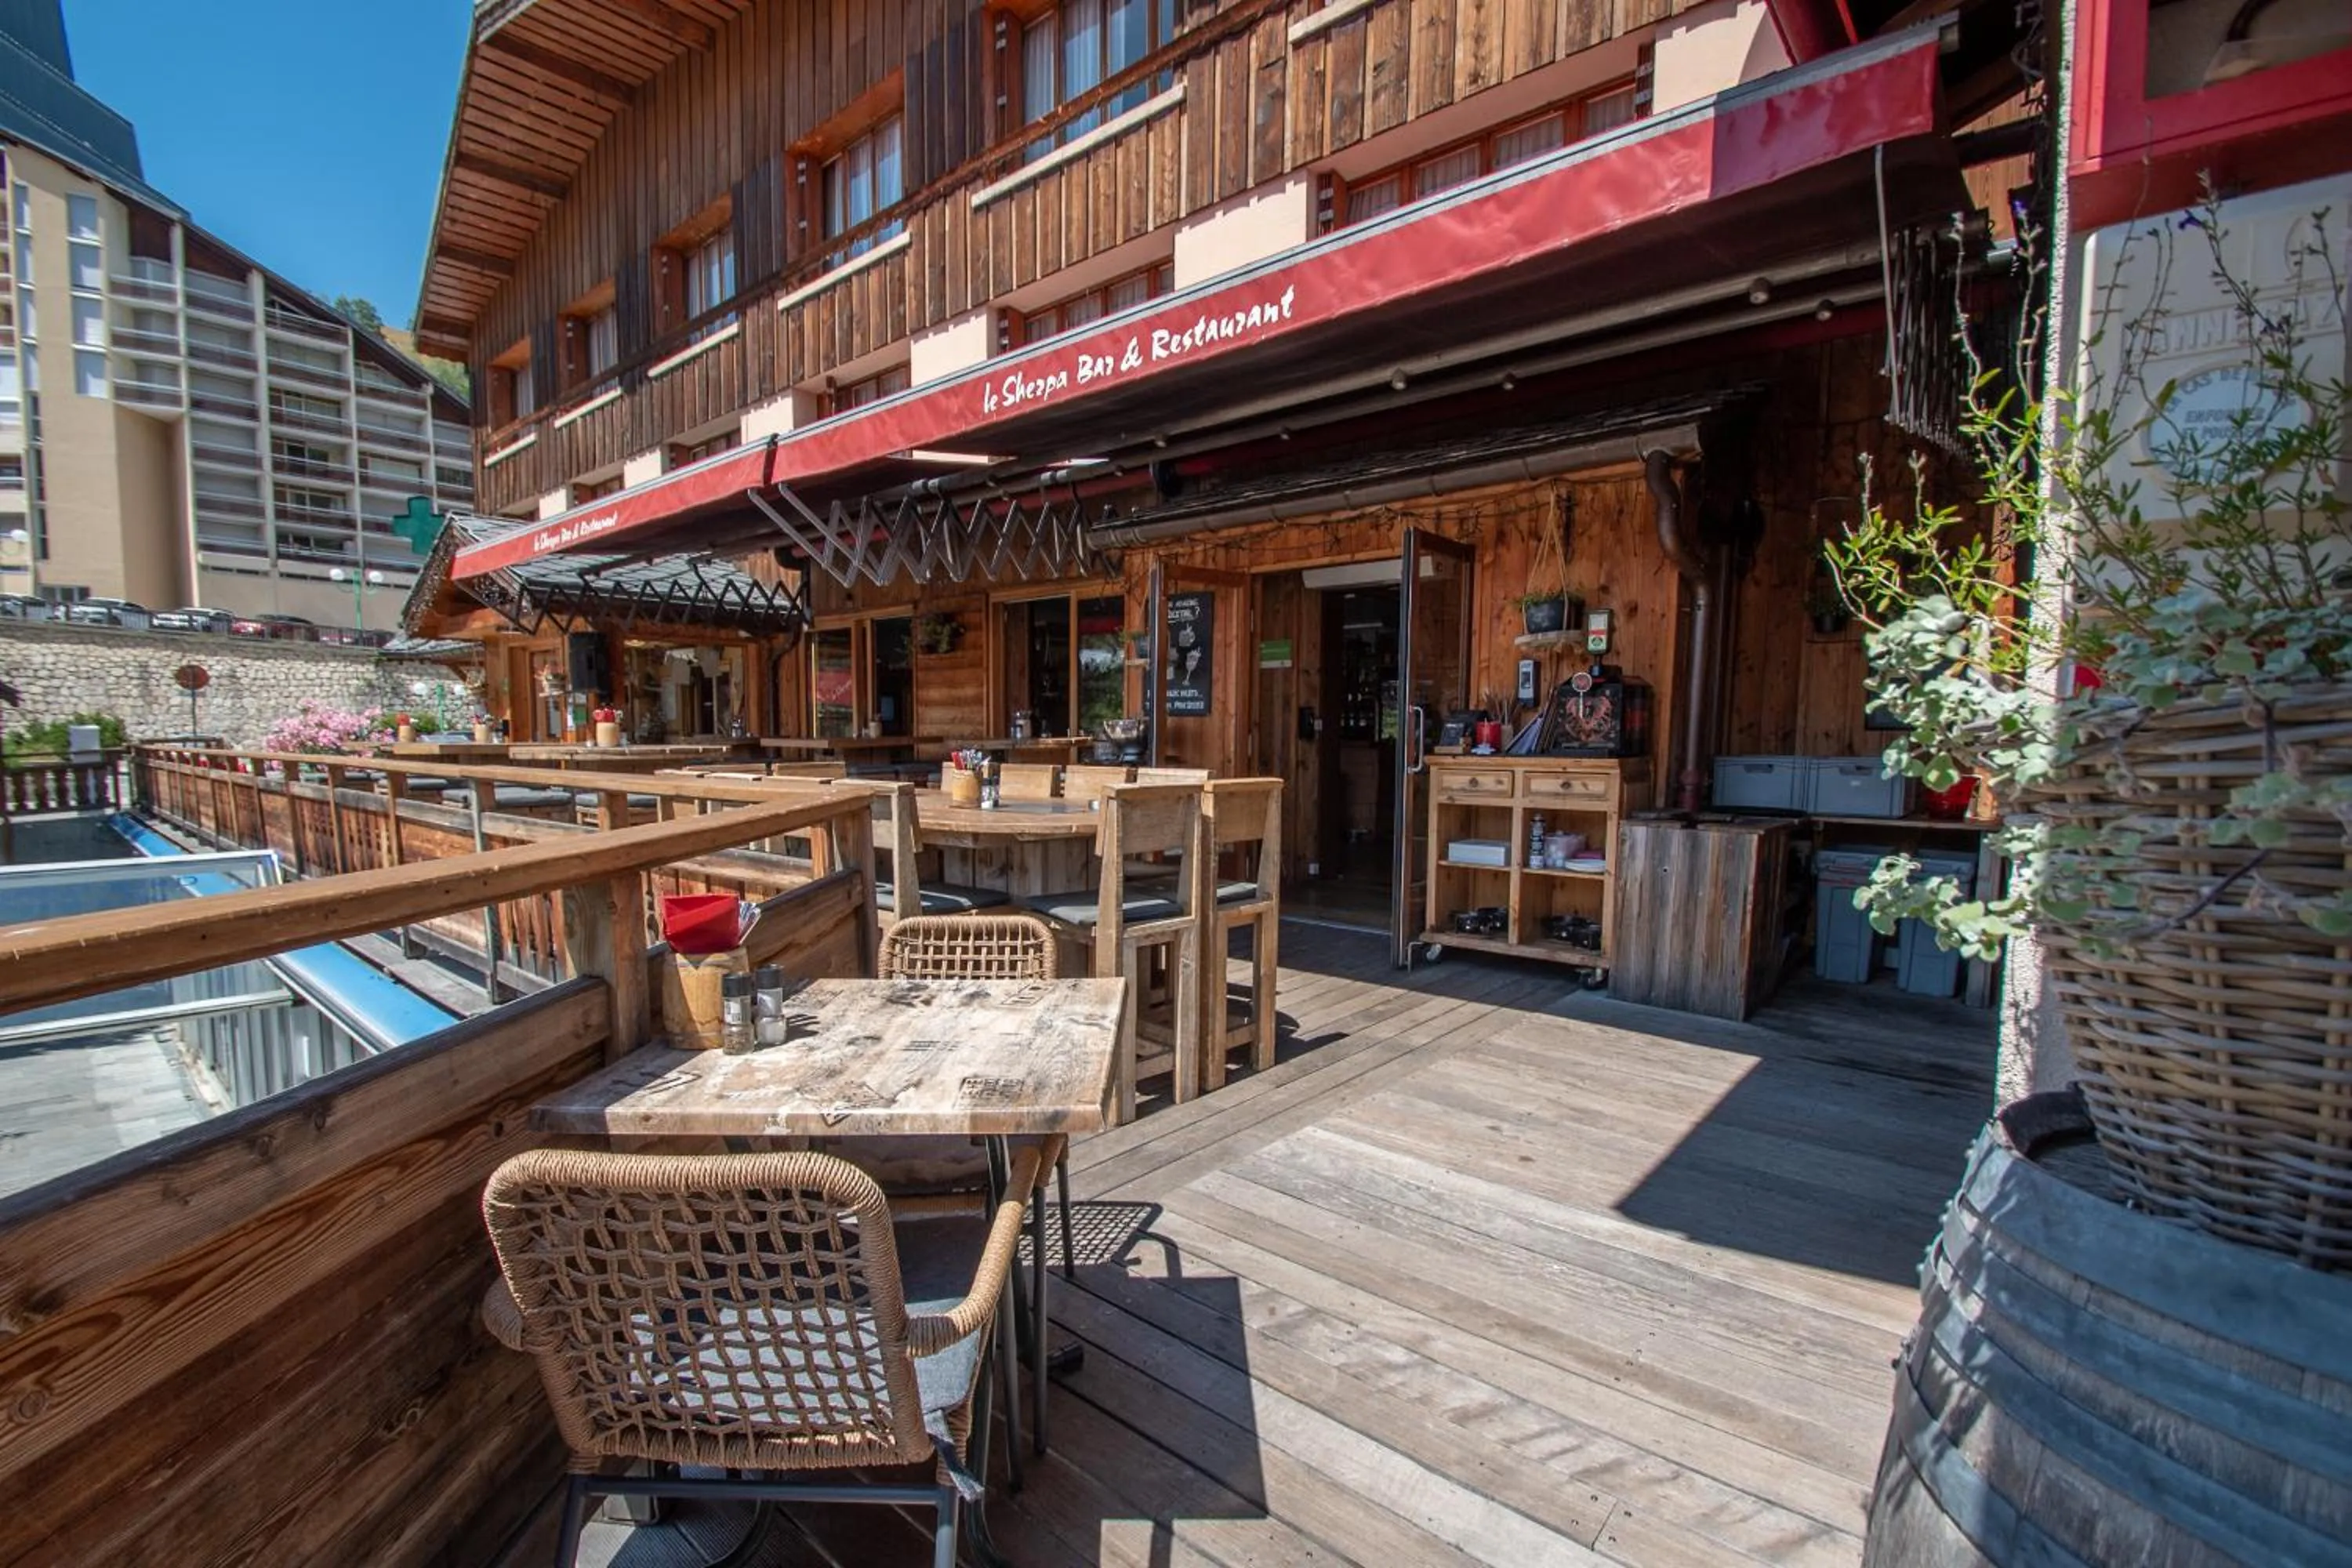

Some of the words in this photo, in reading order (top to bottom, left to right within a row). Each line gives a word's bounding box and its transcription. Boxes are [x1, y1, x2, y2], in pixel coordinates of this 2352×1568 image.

[984, 382, 997, 414] le
[1002, 369, 1068, 407] Sherpa
[1077, 354, 1114, 384] Bar
[1120, 337, 1143, 372] &
[1152, 285, 1295, 361] Restaurant
